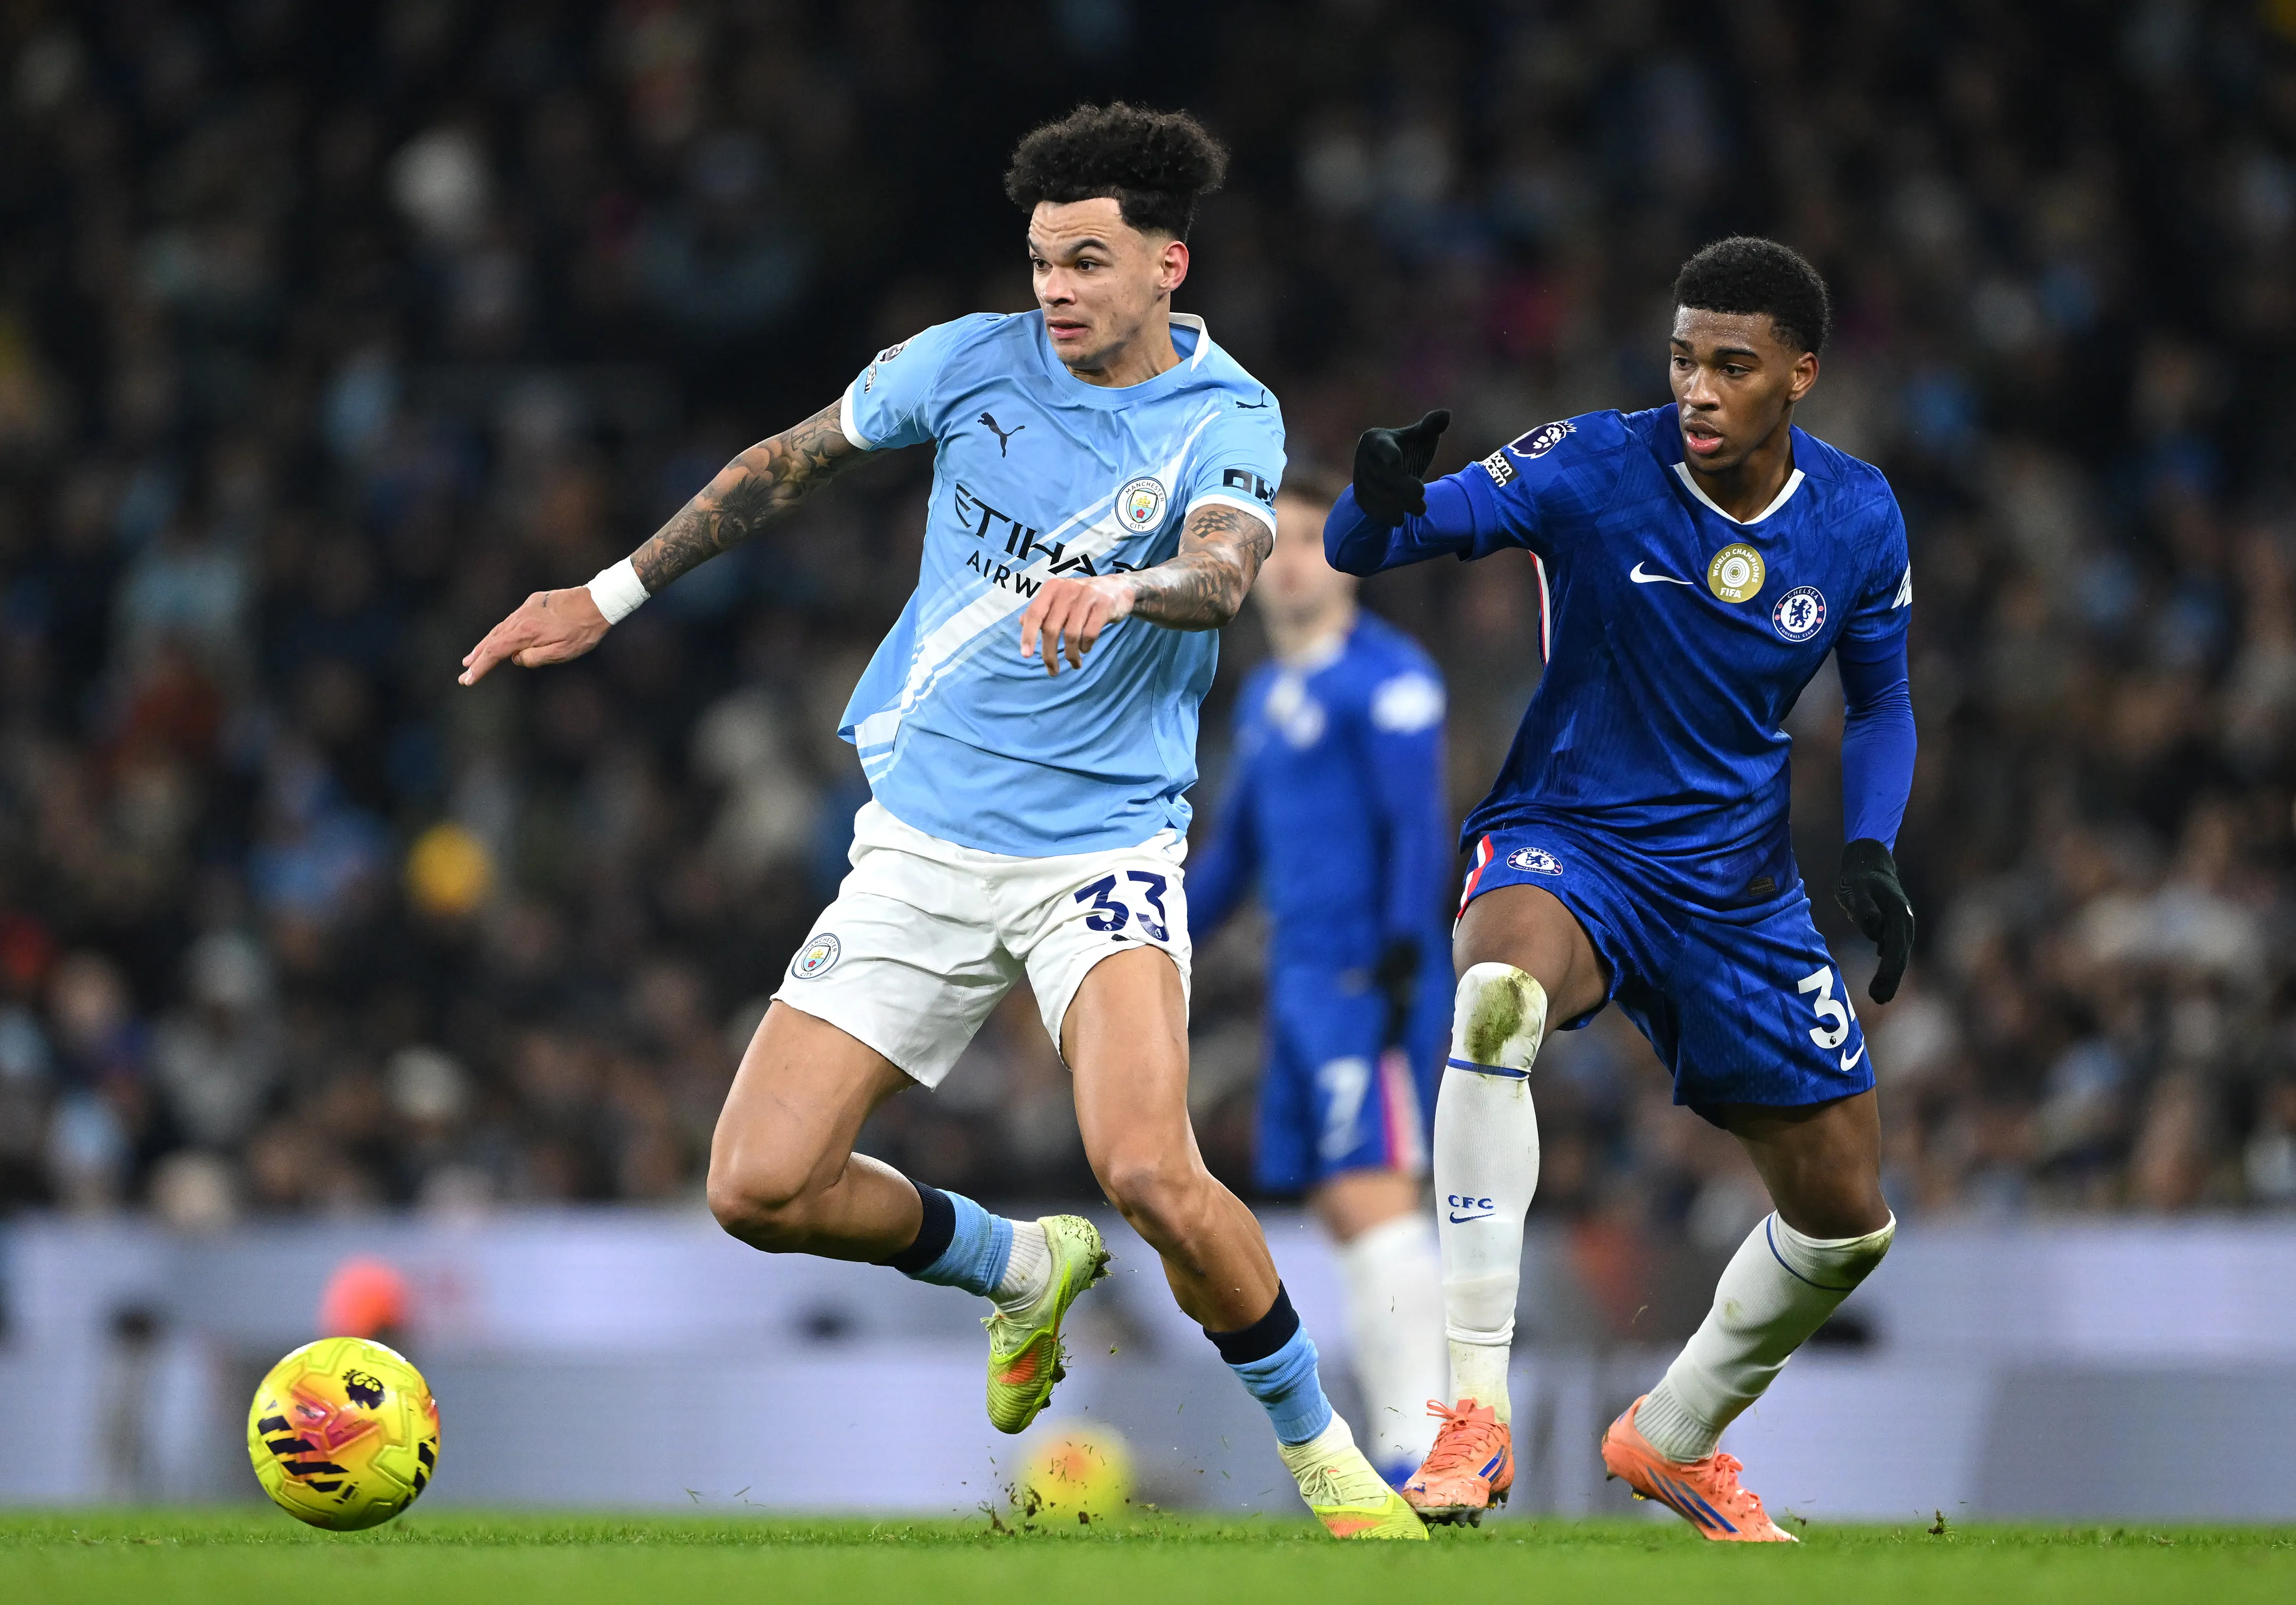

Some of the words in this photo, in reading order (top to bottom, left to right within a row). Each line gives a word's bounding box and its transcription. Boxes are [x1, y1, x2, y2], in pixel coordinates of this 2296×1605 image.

[1125, 481, 1164, 502] MANCHESTER
[1223, 469, 1276, 507] OK
[955, 482, 1151, 576] ETIHA
[966, 550, 1042, 599] AIRW
[1712, 551, 1731, 577] WORLD
[1732, 548, 1760, 583] CHAMPIONS
[1720, 587, 1742, 599] FIFA
[1787, 588, 1819, 600] CHELSEA
[1779, 627, 1800, 638] FOOTBALL
[1802, 629, 1813, 637] CLUB
[1074, 870, 1170, 941] 33
[805, 937, 837, 953] MANCHESTER
[1448, 1194, 1494, 1209] CFC
